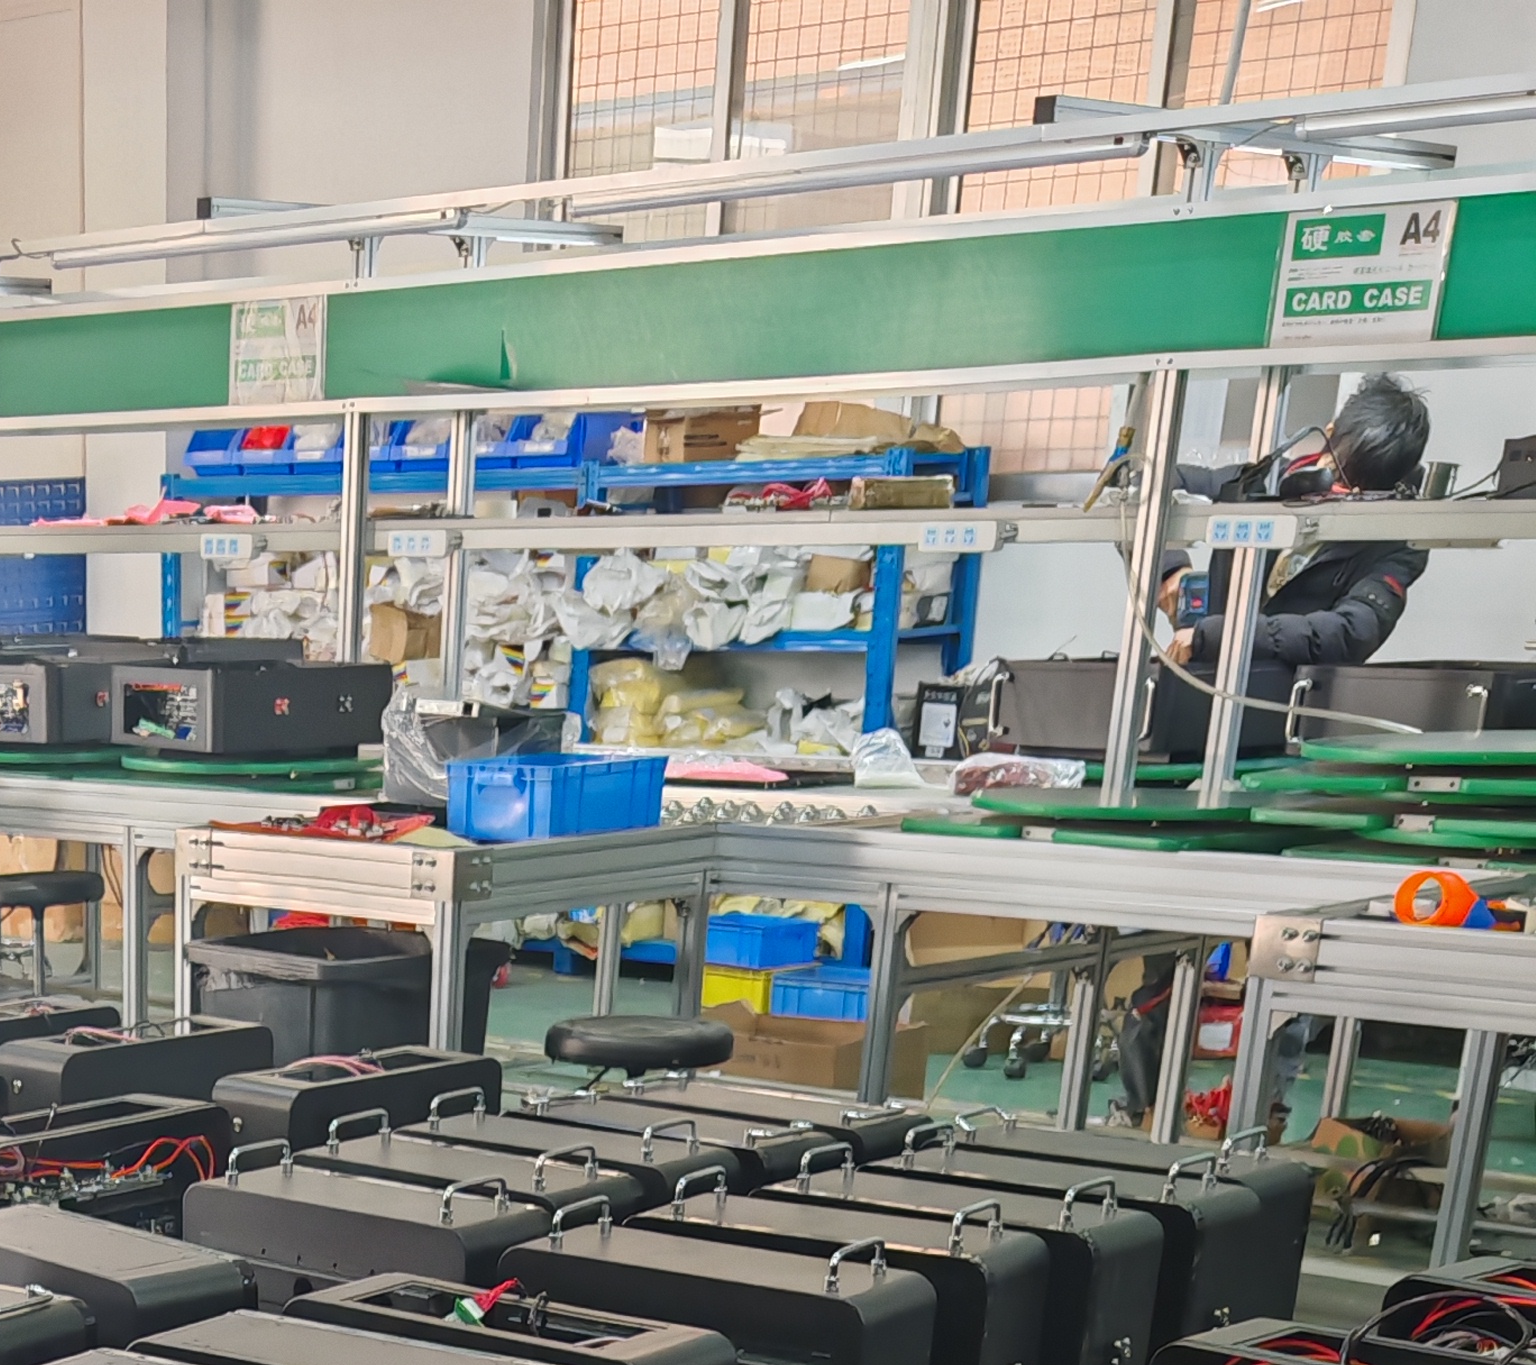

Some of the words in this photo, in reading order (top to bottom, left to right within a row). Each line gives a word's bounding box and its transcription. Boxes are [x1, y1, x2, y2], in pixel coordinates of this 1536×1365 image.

[1400, 210, 1442, 246] A4
[1292, 291, 1352, 312] CARD
[1363, 286, 1424, 308] CASE
[296, 304, 317, 330] A4
